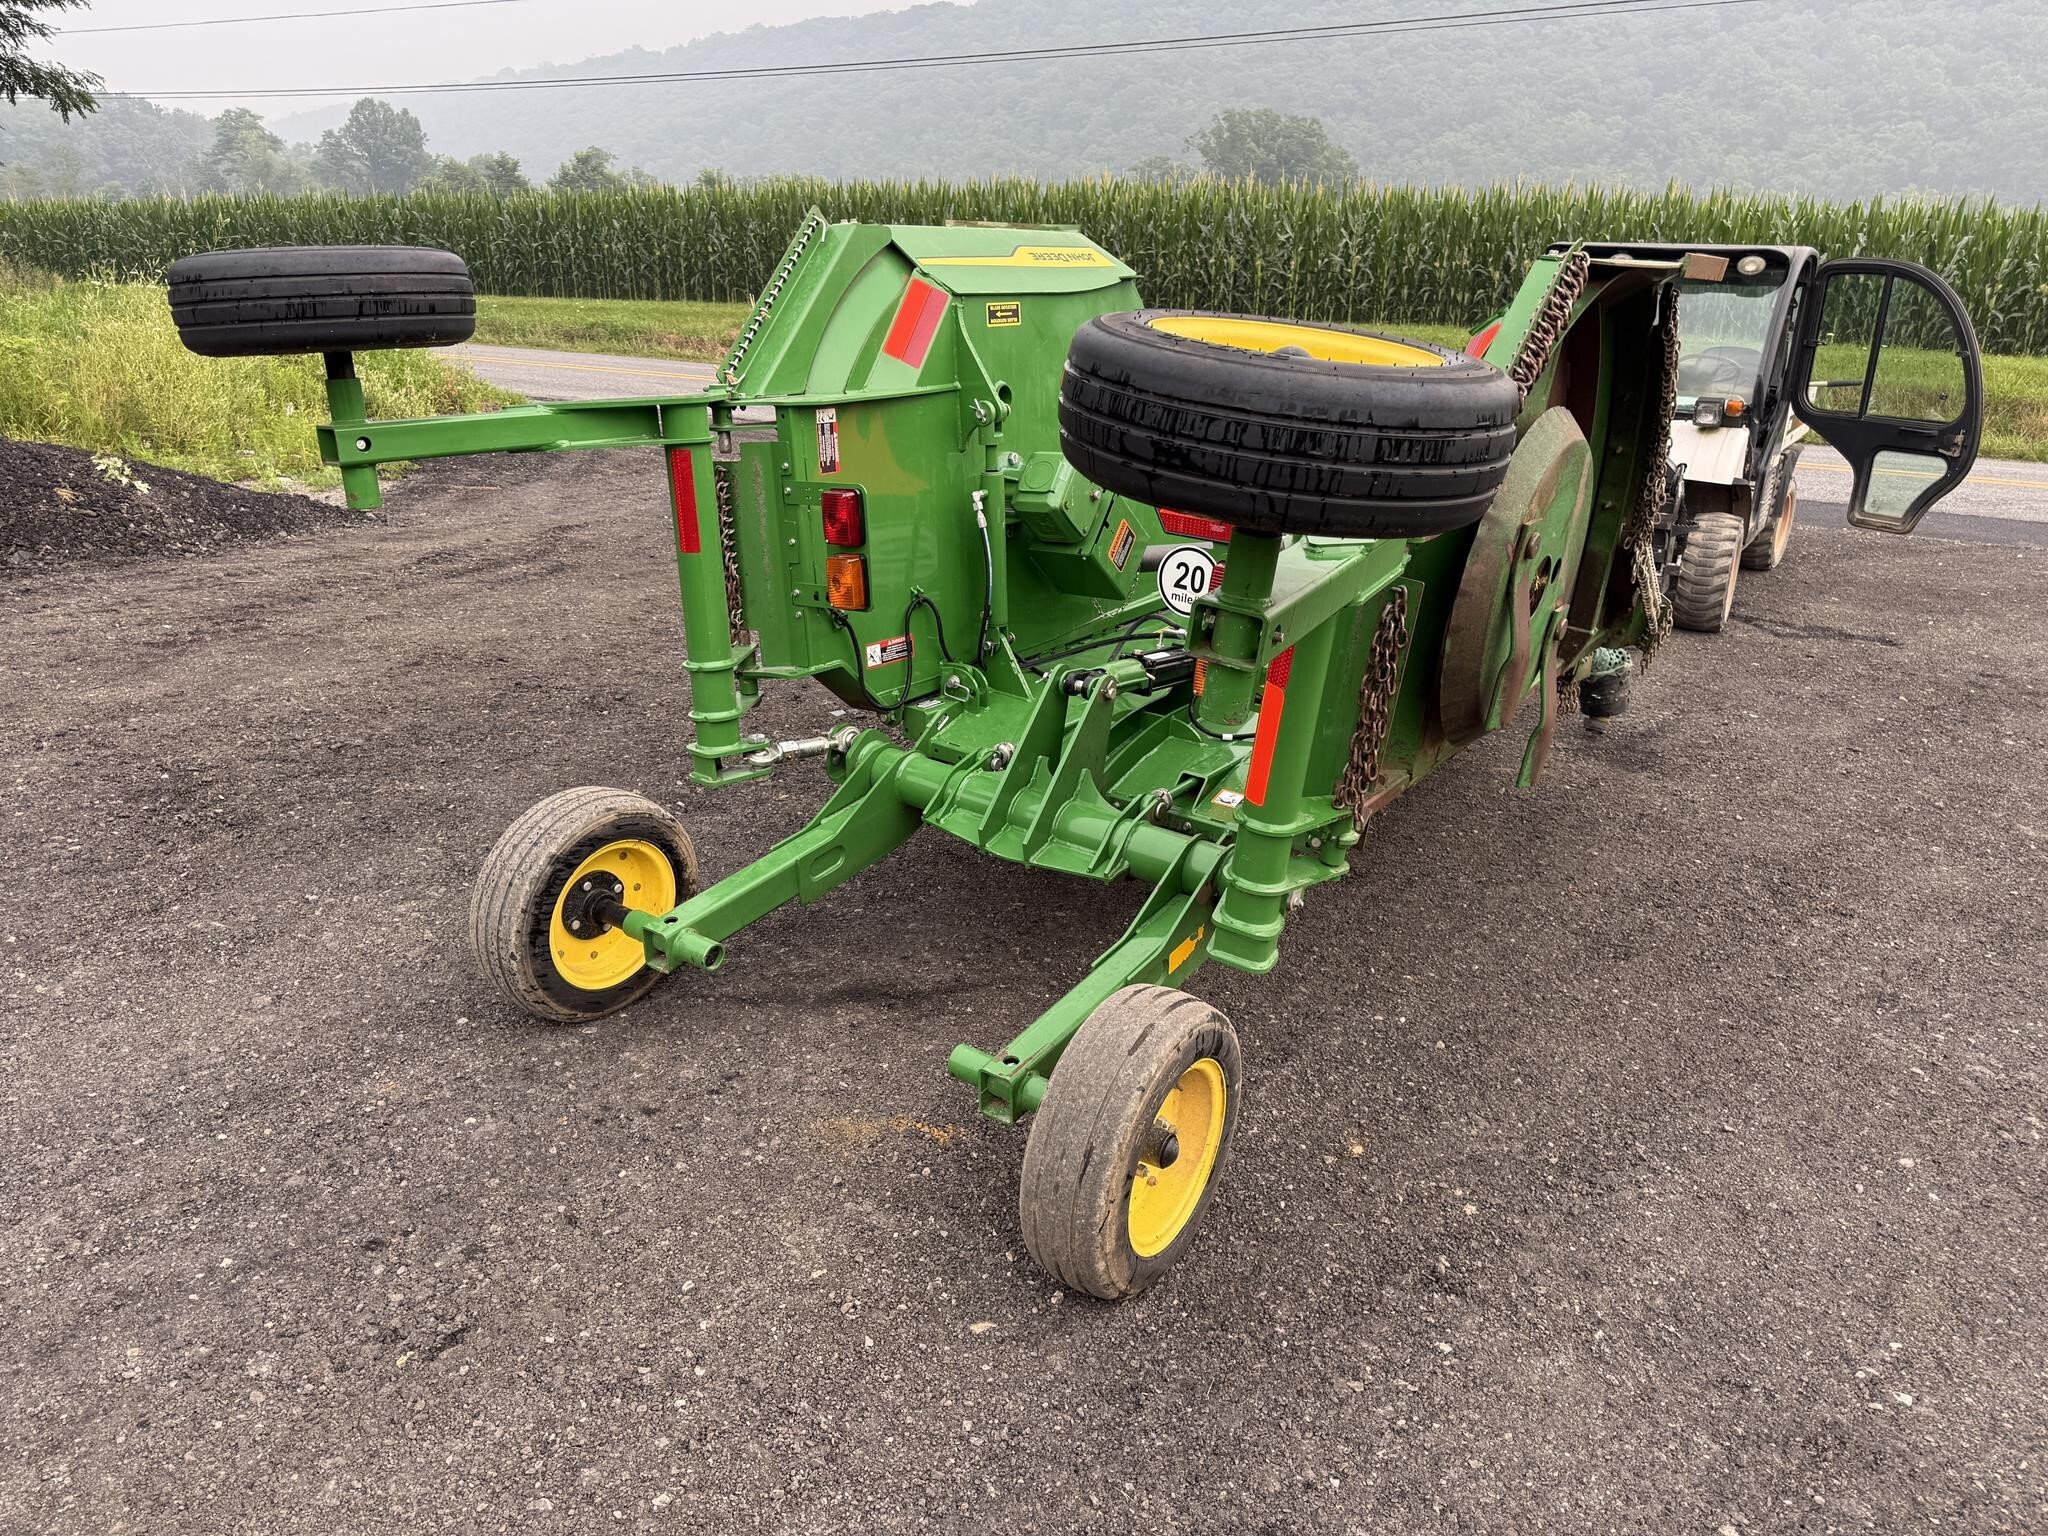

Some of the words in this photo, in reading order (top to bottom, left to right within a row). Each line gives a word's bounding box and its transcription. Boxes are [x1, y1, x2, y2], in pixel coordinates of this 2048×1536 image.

[1028, 252, 1070, 262] DEERE
[1067, 252, 1096, 262] JOHN
[1173, 562, 1205, 593] 20
